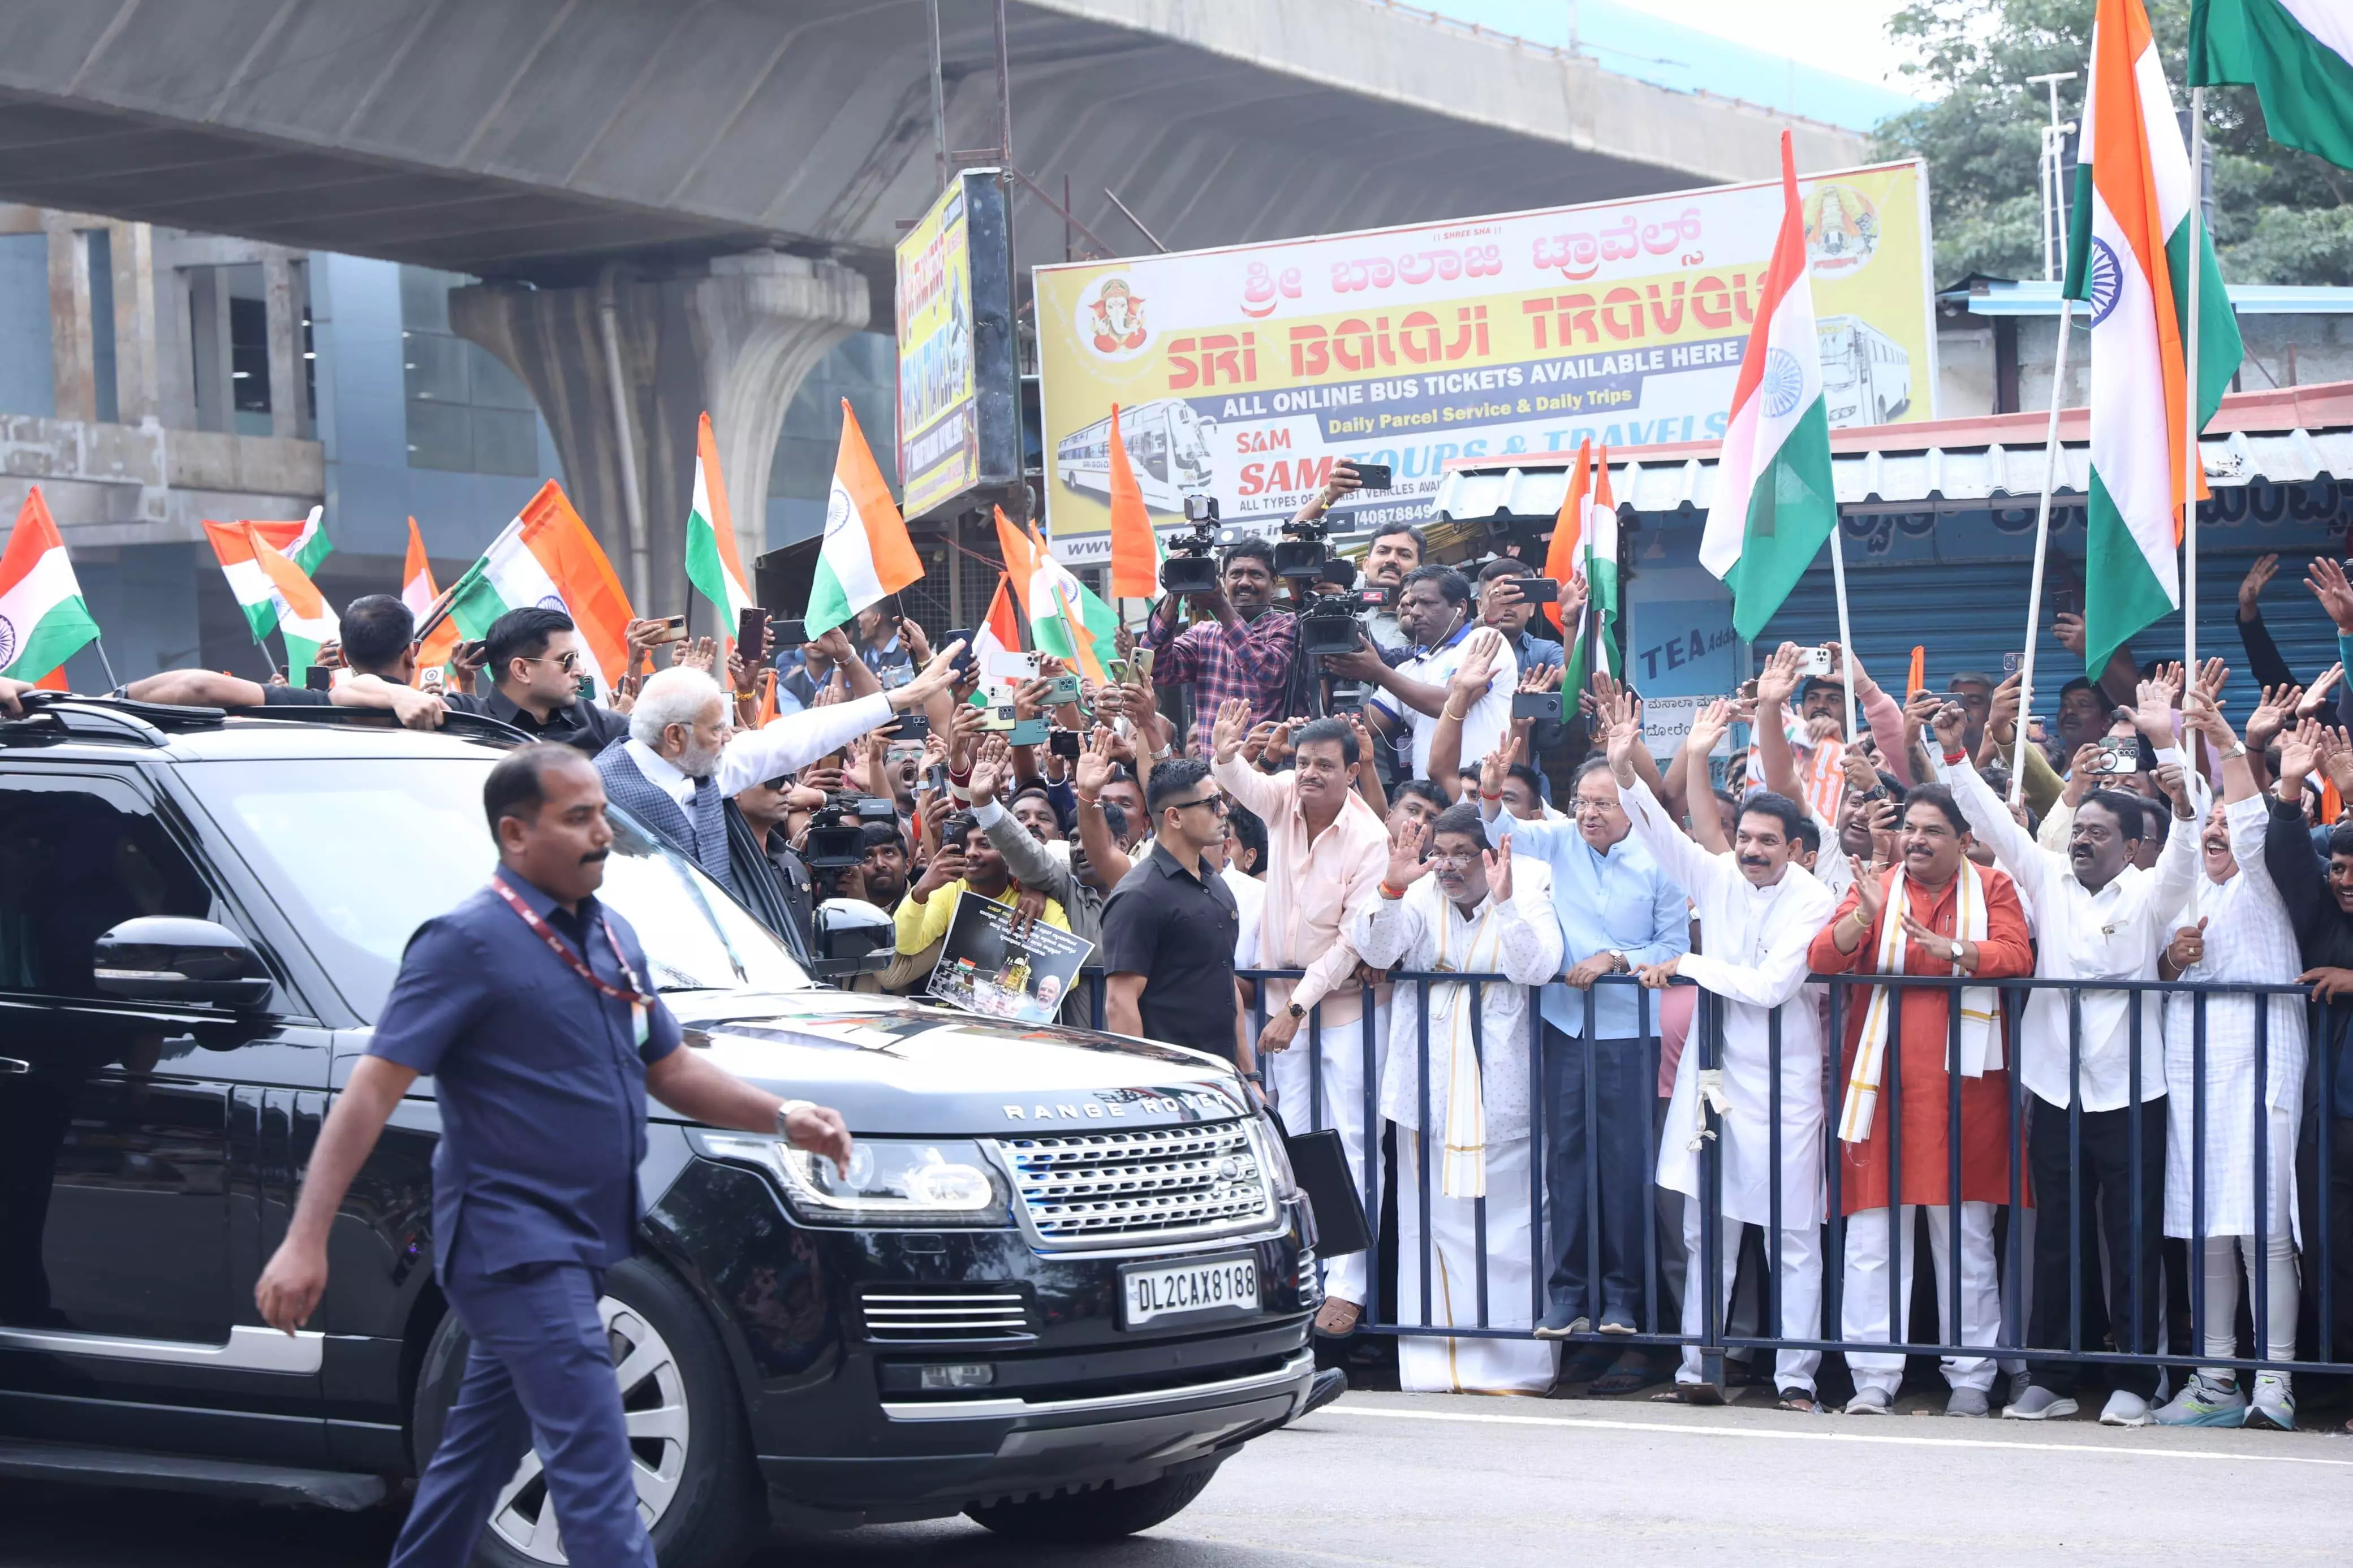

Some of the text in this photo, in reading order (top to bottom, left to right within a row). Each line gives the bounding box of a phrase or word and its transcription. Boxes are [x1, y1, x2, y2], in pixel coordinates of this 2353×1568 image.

[1443, 229, 1472, 240] SHREE
[1473, 227, 1491, 236] SHA
[1240, 260, 1303, 318] ಶ್ರೀ
[1331, 244, 1503, 293] ಬಾಲಾಜಿ
[1222, 340, 1739, 418] ALL ONLINE BUS TICKETS AVAILABLE HERE
[1329, 388, 1633, 435] Daily Parcel Service & Daily Trips
[1236, 428, 1292, 453] SAM
[1238, 456, 1334, 496] SAM
[1240, 498, 1259, 512] ALL
[1263, 495, 1297, 510] TYPES
[1300, 494, 1315, 506] OF
[1366, 482, 1414, 498] VEHICLES
[1640, 628, 1706, 680] TEA
[1002, 1091, 1227, 1121] RANGE ROVER
[1138, 1265, 1255, 1312] DL2CAX8188
